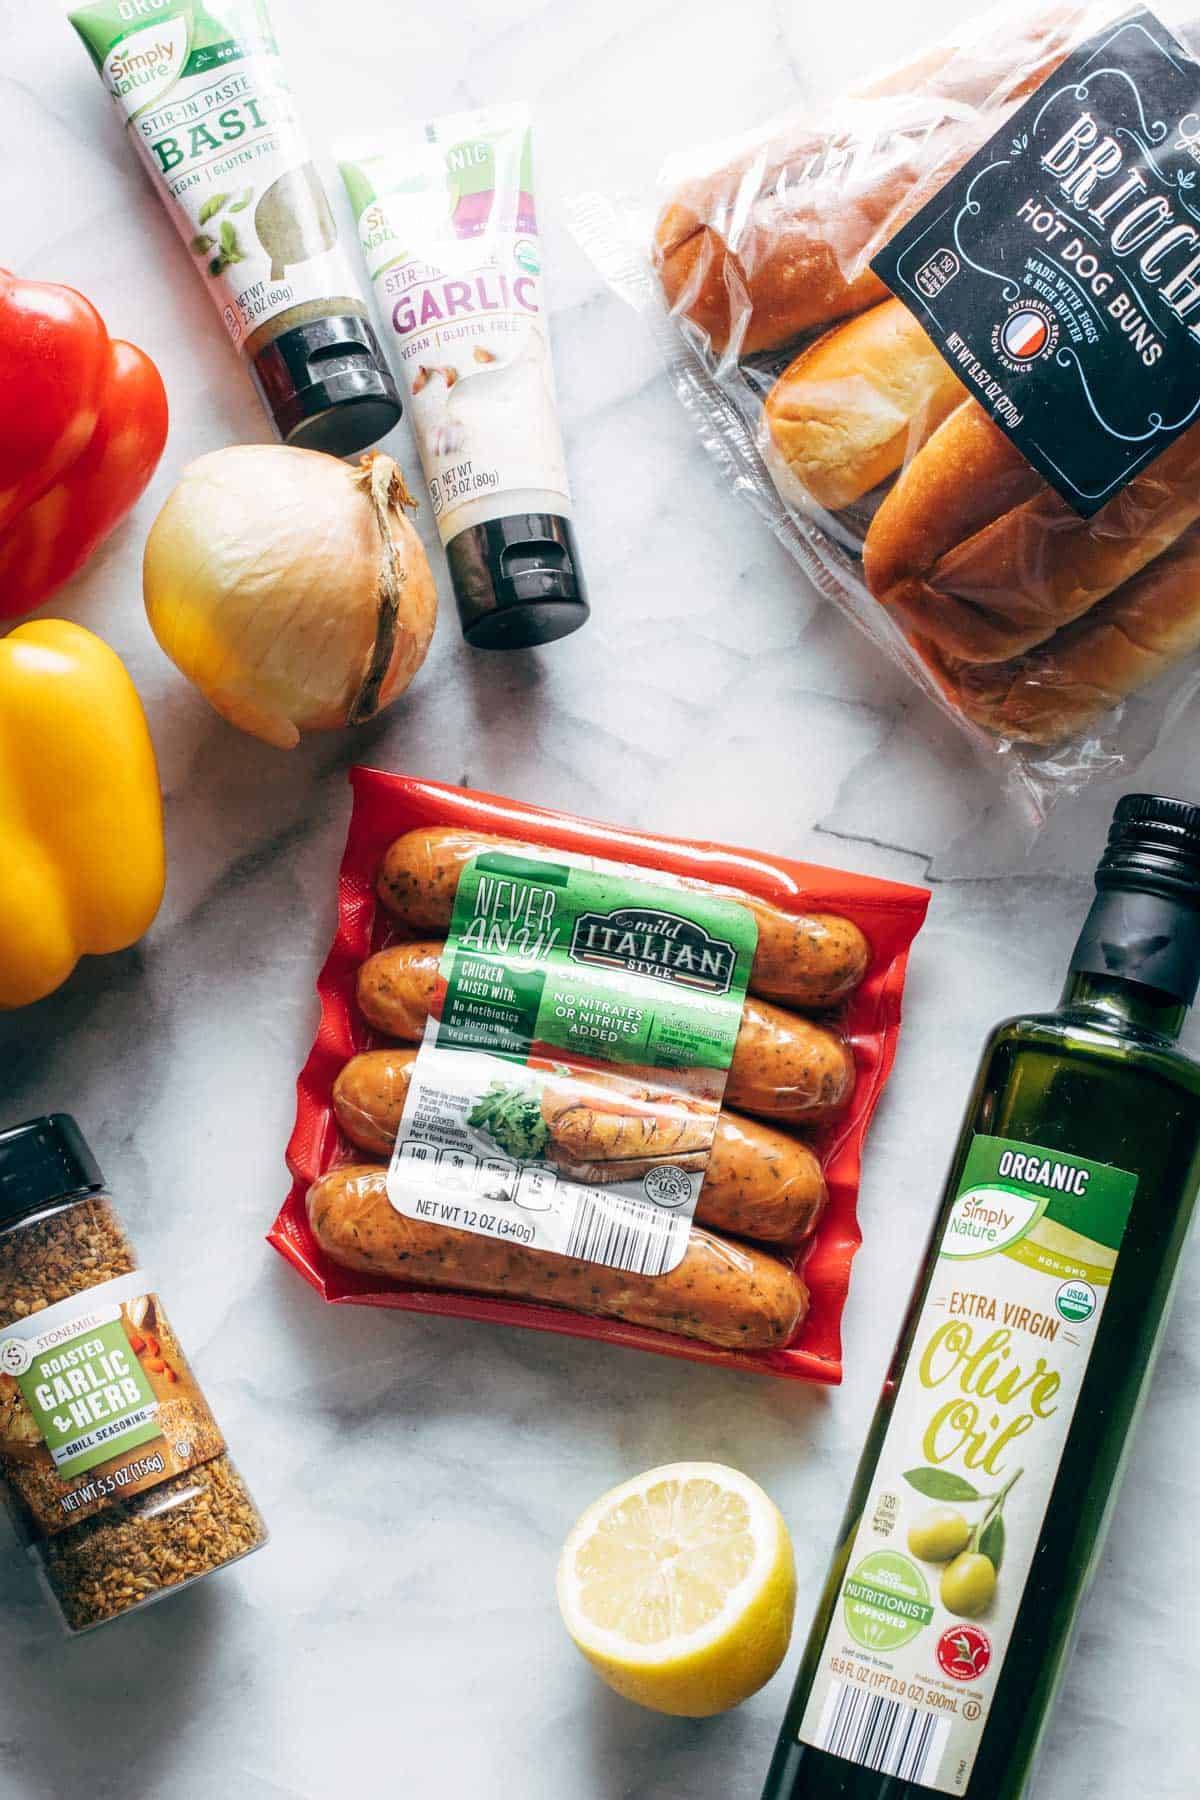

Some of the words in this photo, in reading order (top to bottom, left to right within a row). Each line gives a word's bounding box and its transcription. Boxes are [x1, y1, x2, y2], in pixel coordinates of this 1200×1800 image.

[110, 41, 174, 80] Simply
[111, 63, 168, 98] Nature
[142, 101, 199, 136] STIR-IN
[152, 99, 267, 173] BASI
[213, 150, 253, 176] GLUTEN
[1016, 198, 1067, 242] HOT
[1061, 238, 1114, 297] DOG
[1107, 292, 1163, 367] BUNS
[254, 297, 267, 313] OZ
[268, 286, 293, 306] (80g)
[392, 275, 539, 335] GARLIC
[1007, 299, 1056, 322] AUTHENTIC
[1023, 273, 1033, 285] &
[1033, 279, 1058, 302] RICH
[1054, 299, 1084, 343] BUTTER
[1024, 257, 1057, 282] MADE
[1055, 277, 1084, 311] WITH
[1078, 311, 1100, 344] EGGS
[401, 337, 430, 361] VEGAN
[945, 331, 965, 353] NET
[957, 346, 976, 368] WT
[998, 355, 1032, 373] FRANCE
[985, 381, 1003, 401] OZ
[993, 395, 1024, 429] (270g)
[457, 461, 472, 477] WT
[458, 478, 471, 493] OZ
[473, 469, 499, 489] (80g)
[474, 876, 555, 932] NEVER
[635, 919, 683, 939] mild
[585, 924, 724, 976] ITALIAN
[462, 961, 505, 983] CHICKEN
[627, 959, 673, 979] STYLE
[457, 978, 489, 997] RAISED
[453, 999, 465, 1011] No
[467, 1002, 519, 1023] Antibiotics
[553, 992, 575, 1005] NO
[578, 997, 643, 1020] NITRATES
[555, 1006, 576, 1019] OR
[578, 1009, 640, 1034] NITRITES
[450, 1015, 461, 1026] No
[569, 1023, 619, 1042] ADDED
[448, 1028, 498, 1046] Vegetarian
[411, 1147, 427, 1161] 140
[998, 1150, 1090, 1196] ORGANIC
[416, 1199, 441, 1216] NET
[441, 1204, 461, 1222] WT
[463, 1209, 476, 1226] 12
[479, 1213, 498, 1231] OZ
[497, 1219, 536, 1243] (340g)
[961, 1197, 1015, 1230] Simply
[949, 1218, 997, 1241] Nature
[1037, 1255, 1087, 1278] NON-GMO
[1066, 1287, 1089, 1302] USDA
[949, 1291, 996, 1321] EXTRA
[1003, 1302, 1060, 1343] VIRGIN
[40, 1338, 104, 1379] ROASTED
[919, 1319, 1062, 1422] Olive
[35, 1350, 130, 1412] GARLIC
[53, 1414, 73, 1433] &
[68, 1378, 141, 1429] HERB
[66, 1437, 94, 1456] GRILL
[97, 1410, 147, 1441] SEASONING
[923, 1398, 1034, 1476] Oil
[61, 1493, 80, 1513] NET
[79, 1484, 98, 1505] WT
[98, 1476, 115, 1496] 5.5
[115, 1467, 132, 1486] OZ
[132, 1451, 165, 1481] (156g)
[846, 1583, 929, 1620] NUTRITIONIST
